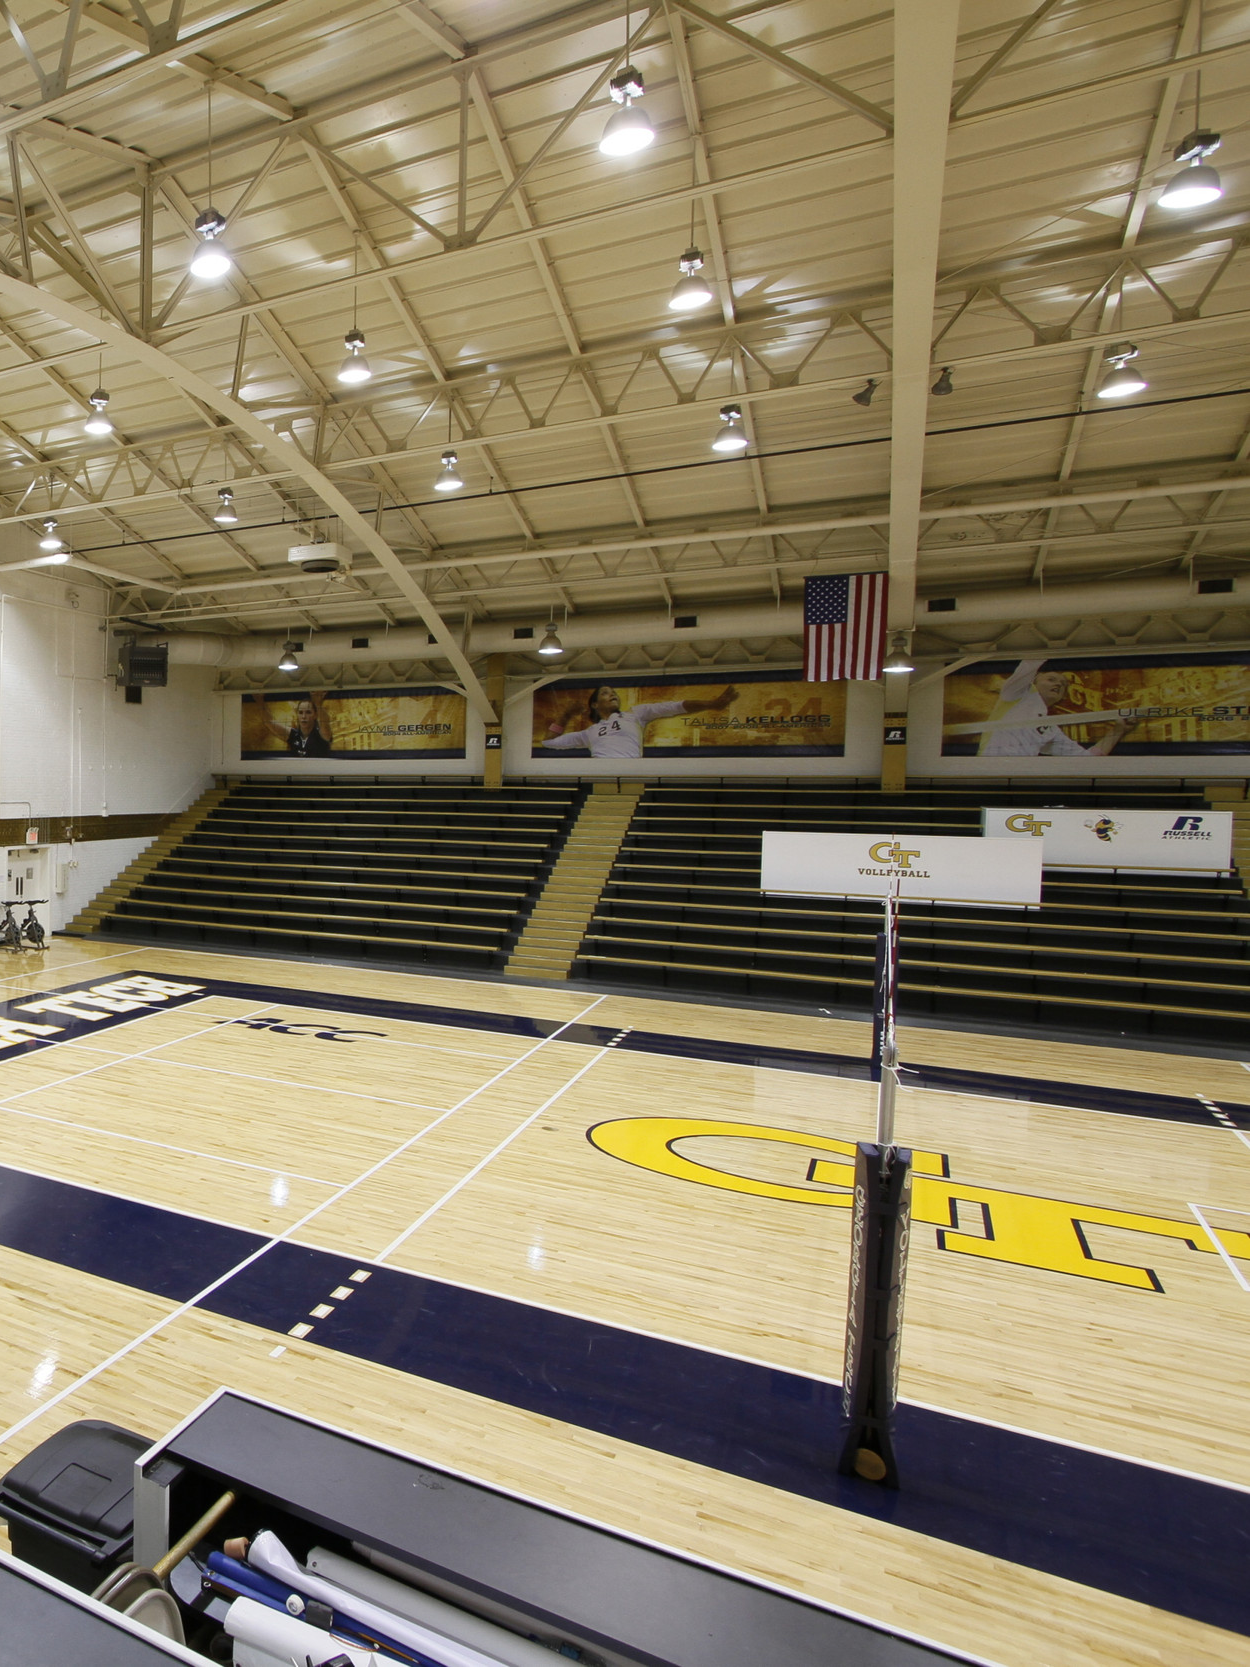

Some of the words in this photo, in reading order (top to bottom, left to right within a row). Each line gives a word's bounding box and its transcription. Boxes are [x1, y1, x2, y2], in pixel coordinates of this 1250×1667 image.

[681, 716, 740, 725] TALISA
[746, 714, 831, 724] KELLOGG
[1117, 706, 1205, 717] ULRIKE
[357, 725, 395, 733] JAYME
[398, 723, 452, 732] GERGEN
[1005, 814, 1052, 836] GT
[868, 842, 920, 868] GT
[858, 868, 930, 878] VOLLEYBALL
[14, 975, 208, 1022] TECH
[212, 1017, 389, 1042] ACC
